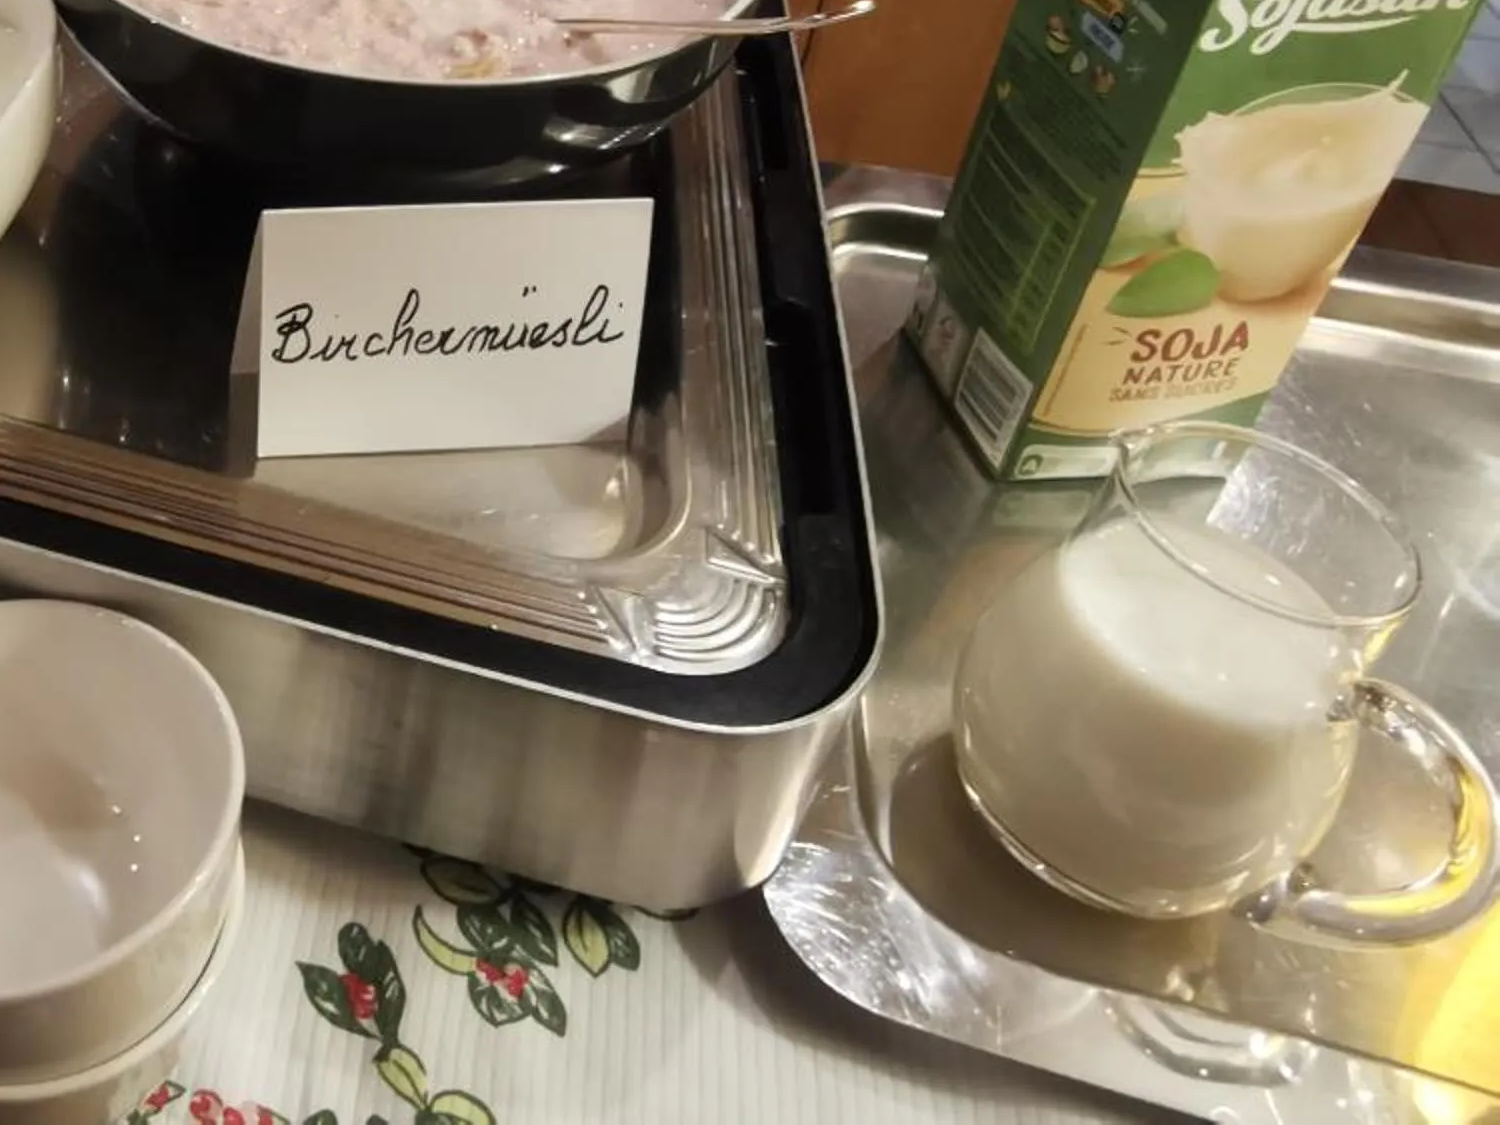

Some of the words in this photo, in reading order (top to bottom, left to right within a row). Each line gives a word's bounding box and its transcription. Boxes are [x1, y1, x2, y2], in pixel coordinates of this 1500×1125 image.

[271, 285, 624, 364] Birchermüesli
[1129, 321, 1250, 363] SOJA
[1122, 357, 1241, 386] NATURE
